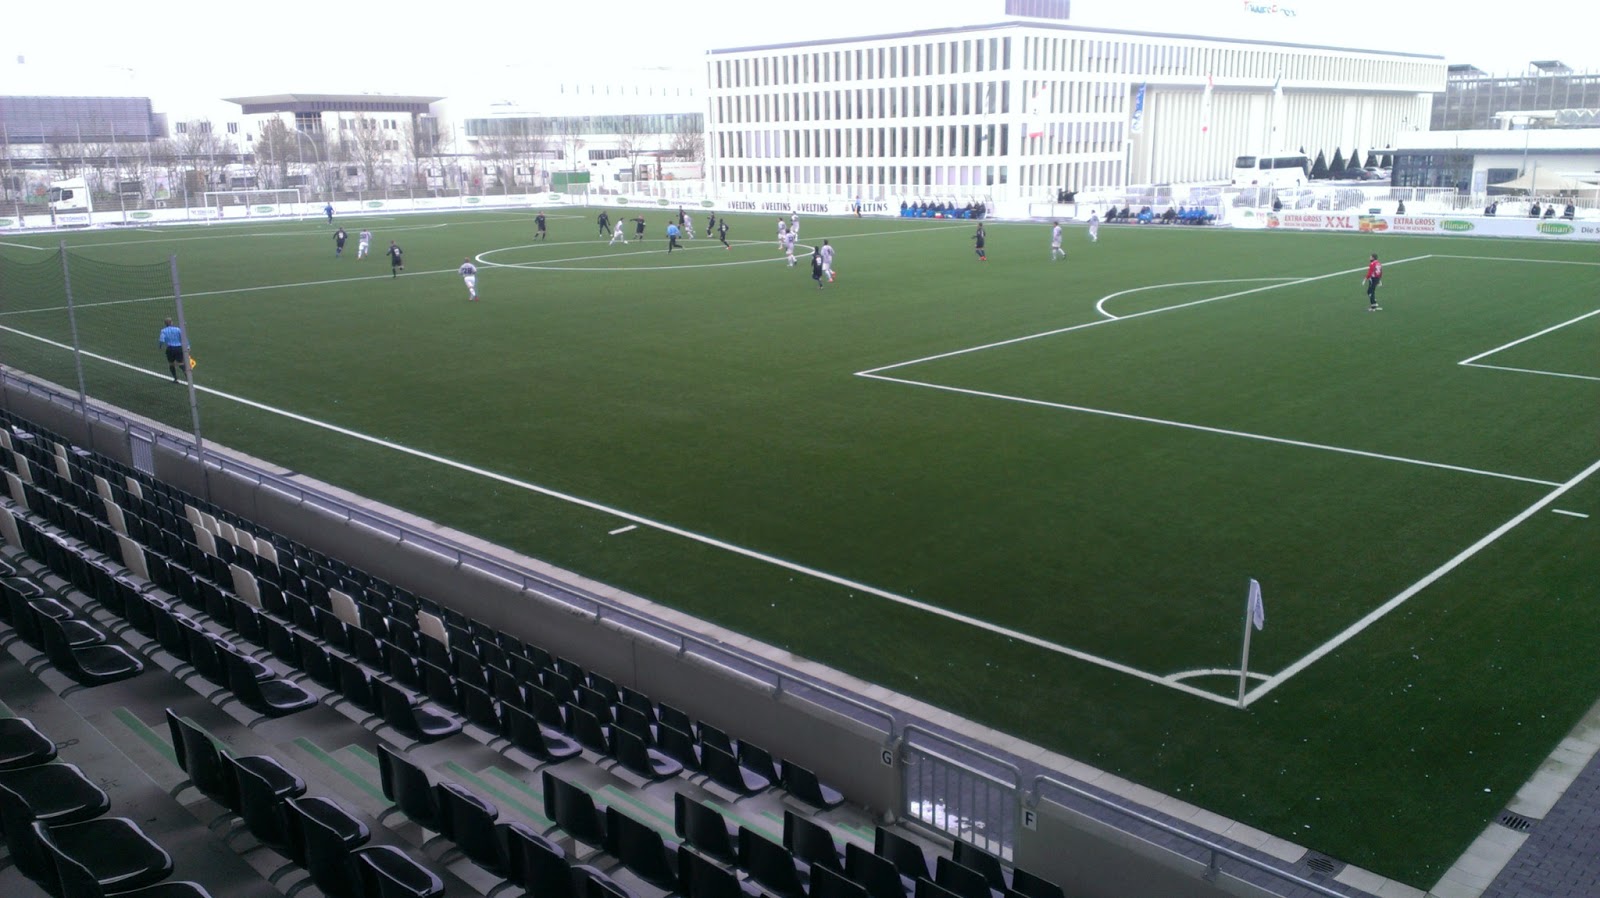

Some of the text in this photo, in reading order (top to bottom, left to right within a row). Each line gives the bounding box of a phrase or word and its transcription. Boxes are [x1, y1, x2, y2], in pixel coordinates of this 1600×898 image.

[732, 201, 756, 210] VELTINS
[766, 202, 791, 212] VELTINS
[802, 203, 828, 213] VELTINS
[851, 203, 888, 212] VLTINS
[1325, 216, 1353, 228] XXL
[1414, 218, 1436, 226] GROSS
[882, 750, 892, 765] G
[1025, 811, 1034, 826] F
